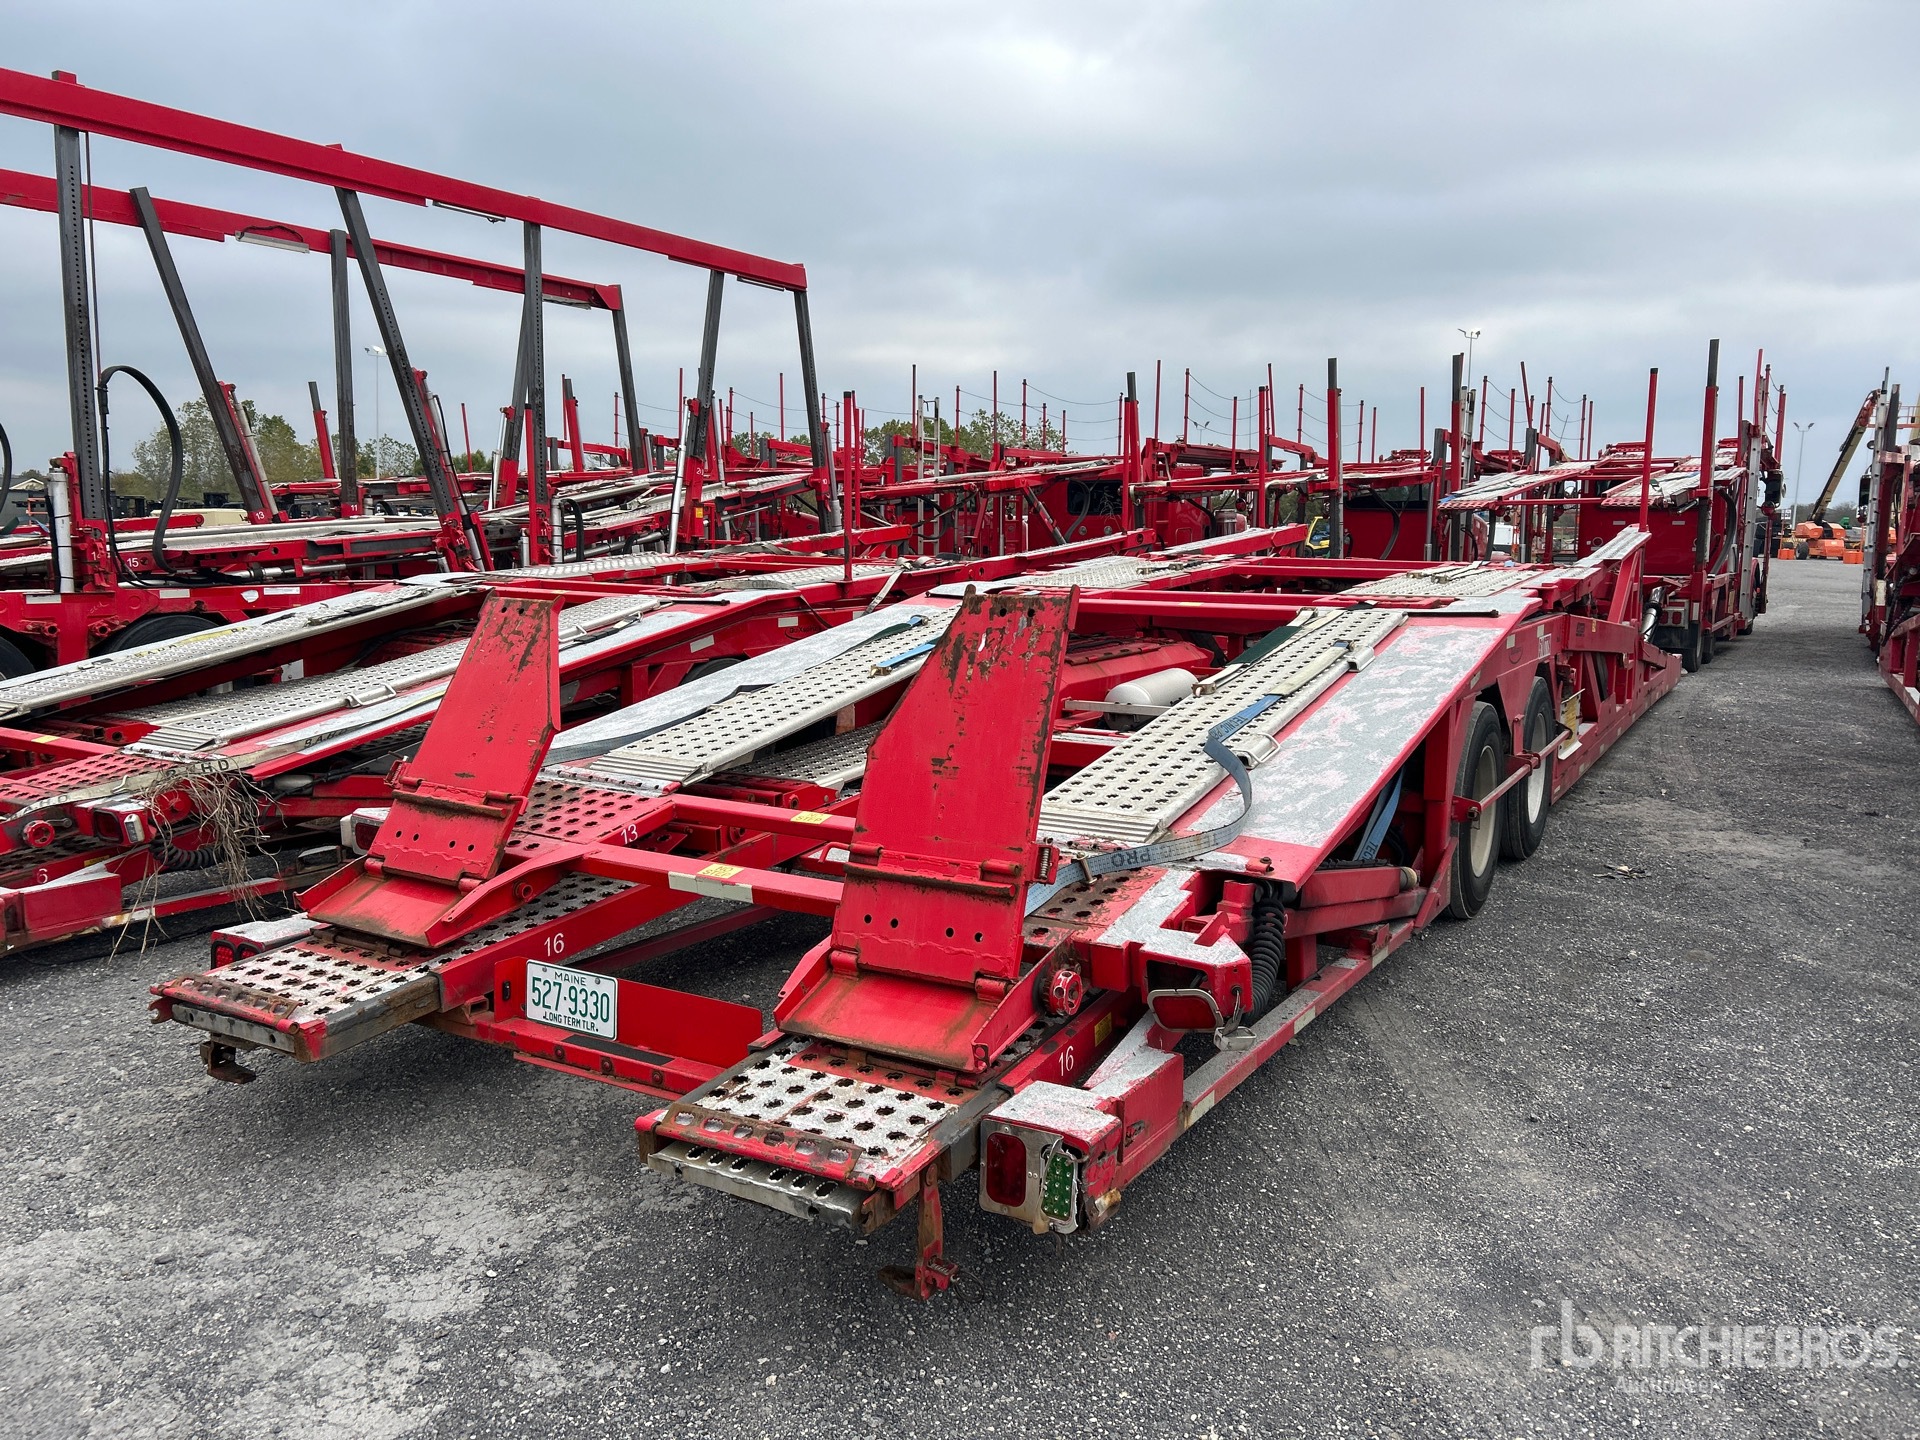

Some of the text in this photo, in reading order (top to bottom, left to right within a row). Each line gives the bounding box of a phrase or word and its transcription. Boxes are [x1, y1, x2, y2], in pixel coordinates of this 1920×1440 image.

[255, 511, 265, 520] 13
[350, 504, 358, 512] 11
[127, 557, 139, 568] 15
[620, 823, 639, 845] 13
[701, 868, 732, 878] STEP
[543, 932, 565, 957] 16
[554, 971, 587, 987] MAINE
[544, 1010, 562, 1024] LONG
[563, 1016, 581, 1028] TERM
[1058, 1045, 1074, 1077] 16
